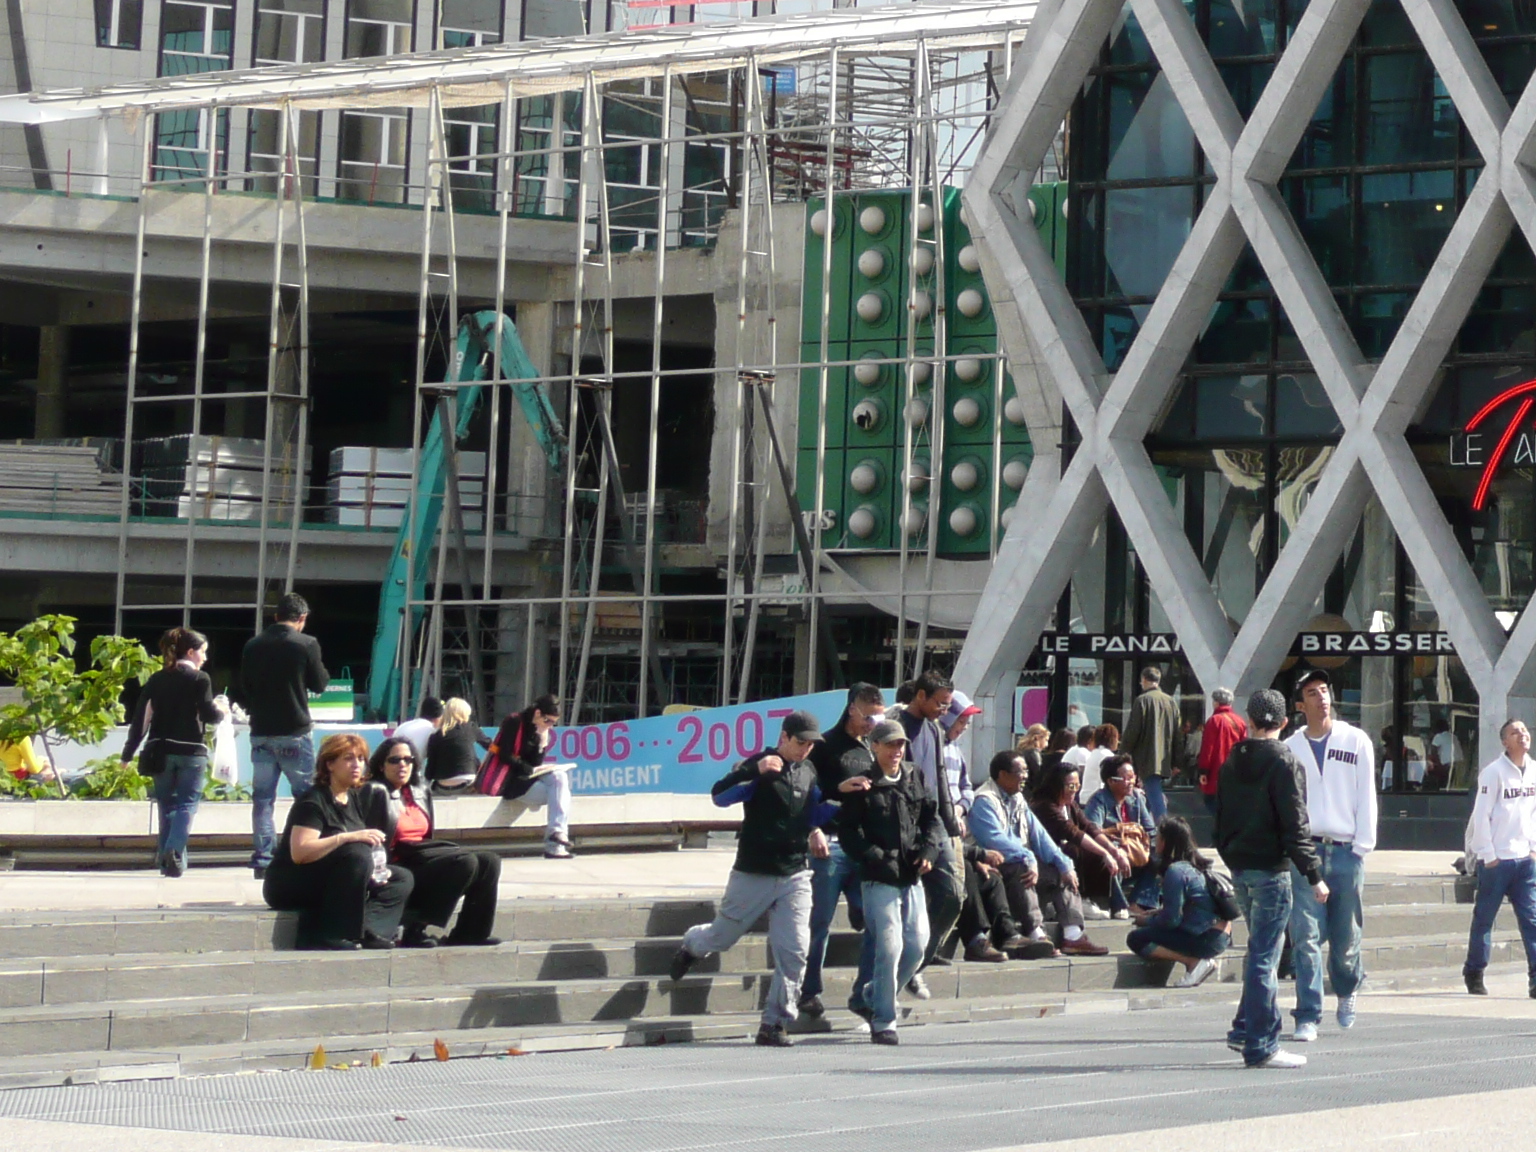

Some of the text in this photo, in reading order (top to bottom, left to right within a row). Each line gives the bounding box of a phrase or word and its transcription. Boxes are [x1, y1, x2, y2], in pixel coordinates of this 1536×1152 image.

[1450, 434, 1483, 466] LE
[1041, 635, 1182, 653] LE PANA
